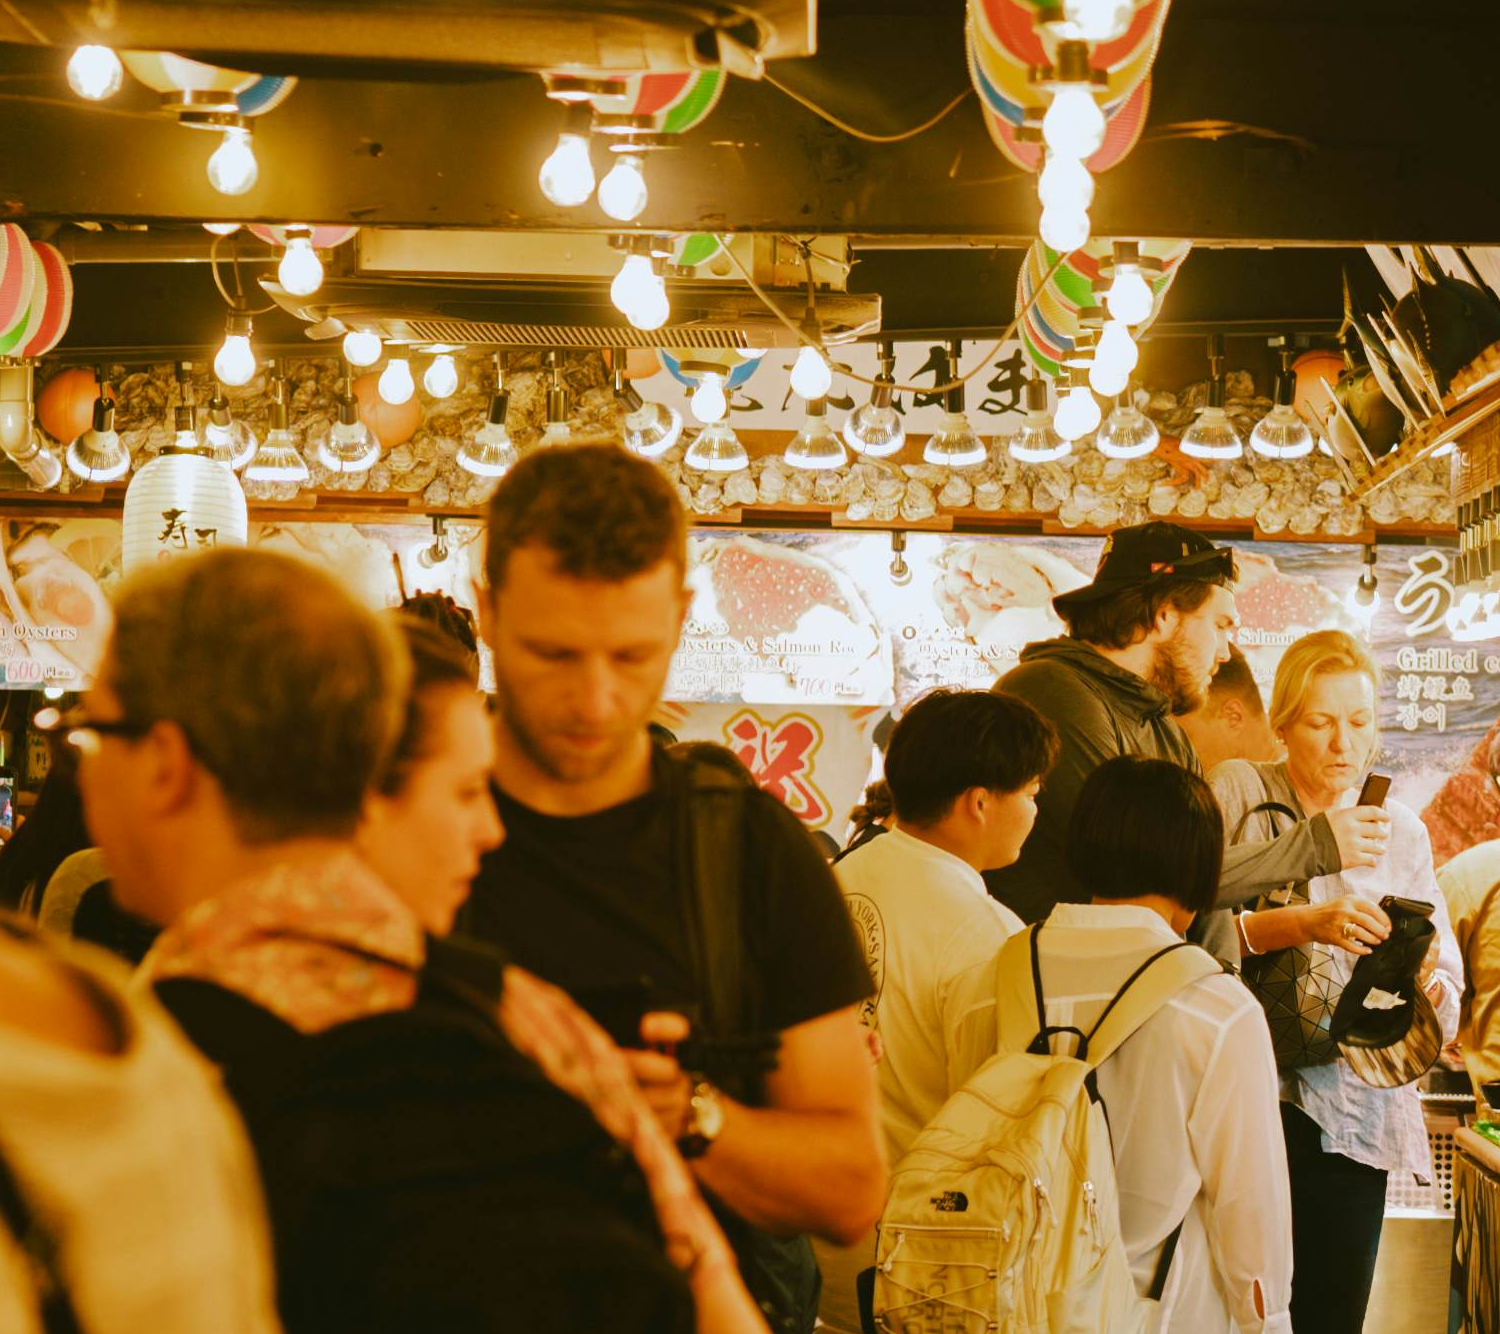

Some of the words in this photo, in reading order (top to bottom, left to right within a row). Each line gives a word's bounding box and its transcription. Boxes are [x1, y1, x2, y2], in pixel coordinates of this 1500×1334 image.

[13, 623, 77, 640] Oysters
[1238, 629, 1296, 645] Salmon
[763, 637, 822, 654] Salmon
[1397, 648, 1478, 673] Grilled
